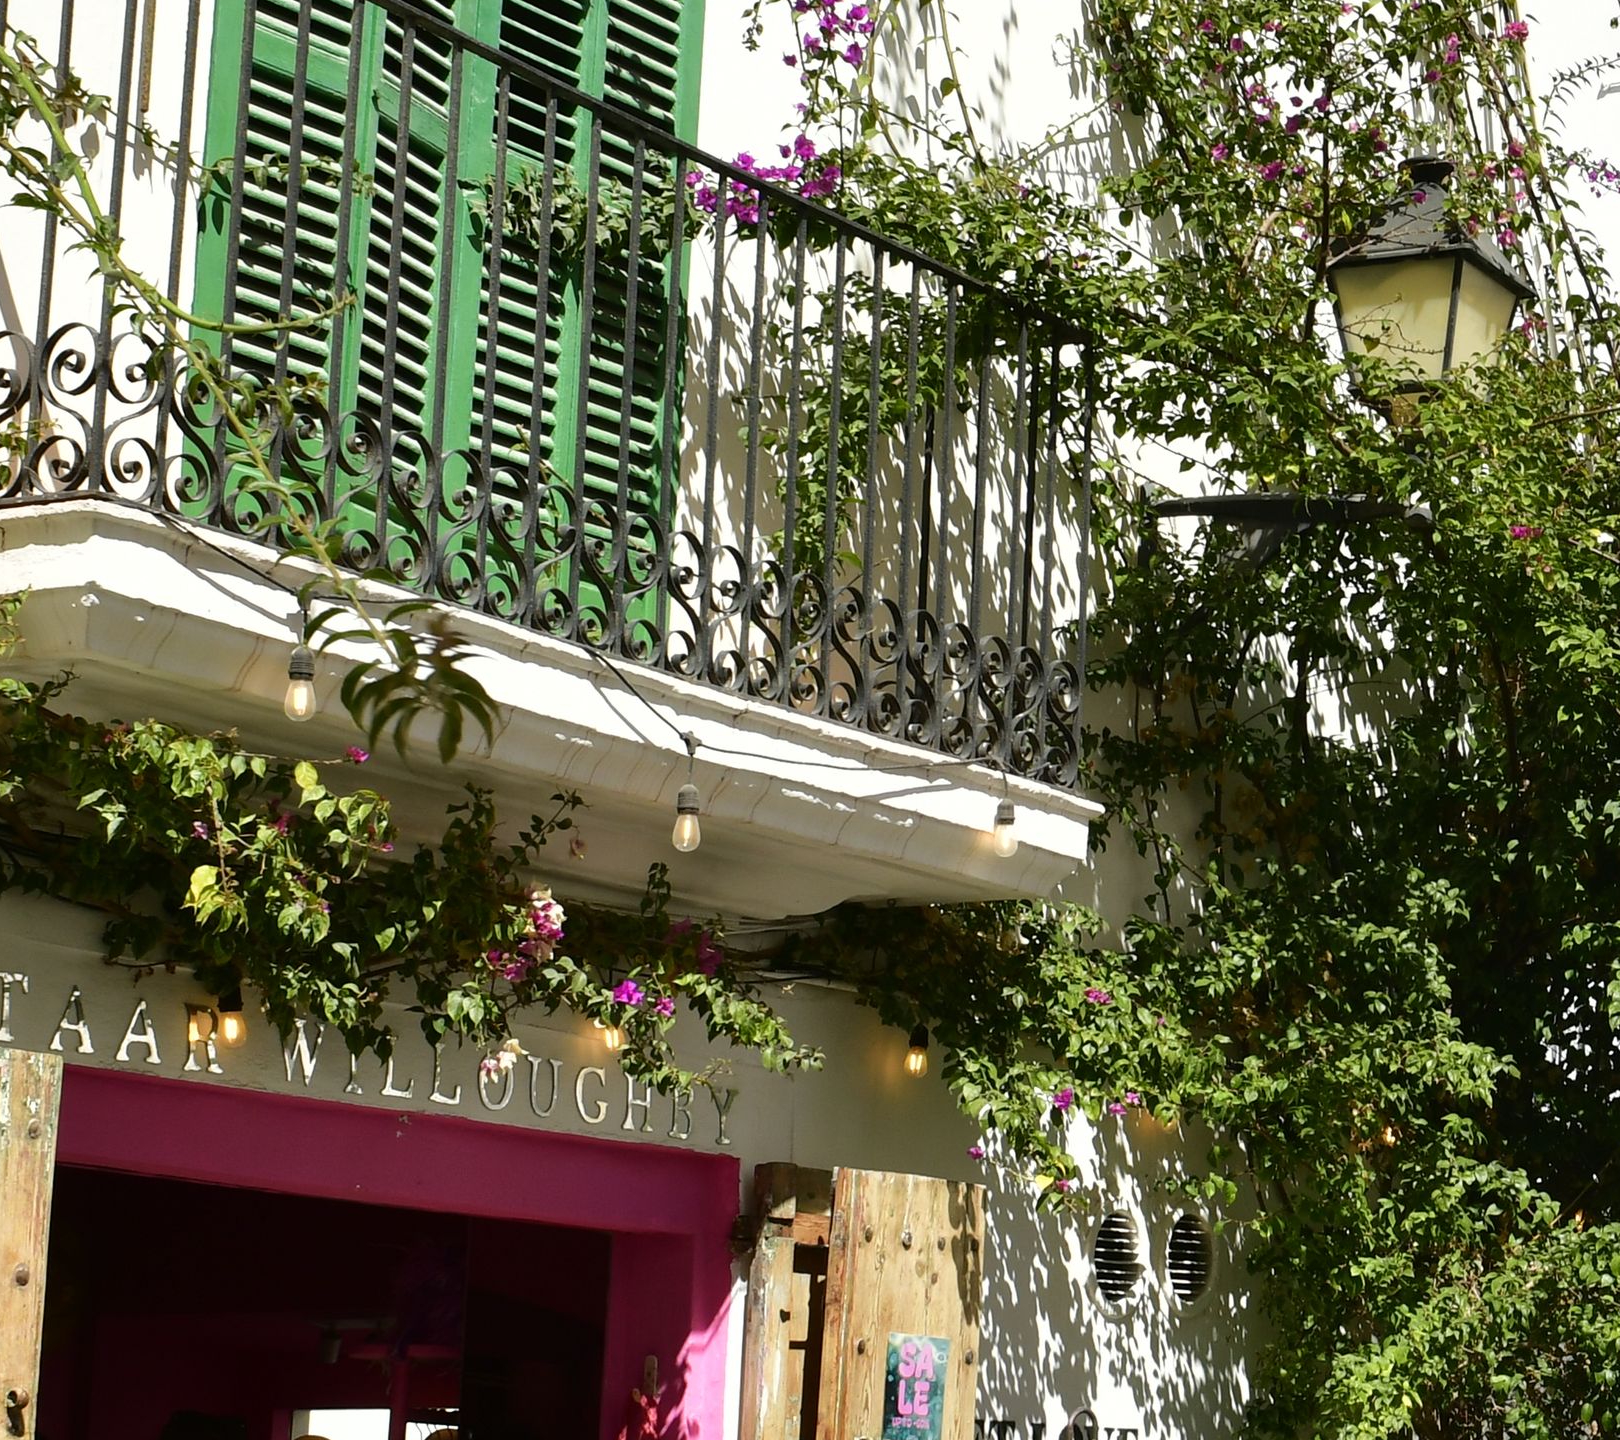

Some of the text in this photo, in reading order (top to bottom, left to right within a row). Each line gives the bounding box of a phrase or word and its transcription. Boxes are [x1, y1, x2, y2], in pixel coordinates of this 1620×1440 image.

[283, 1017, 740, 1146] WILLOUGHBY
[898, 1342, 936, 1379] SA
[897, 1379, 931, 1417] LE
